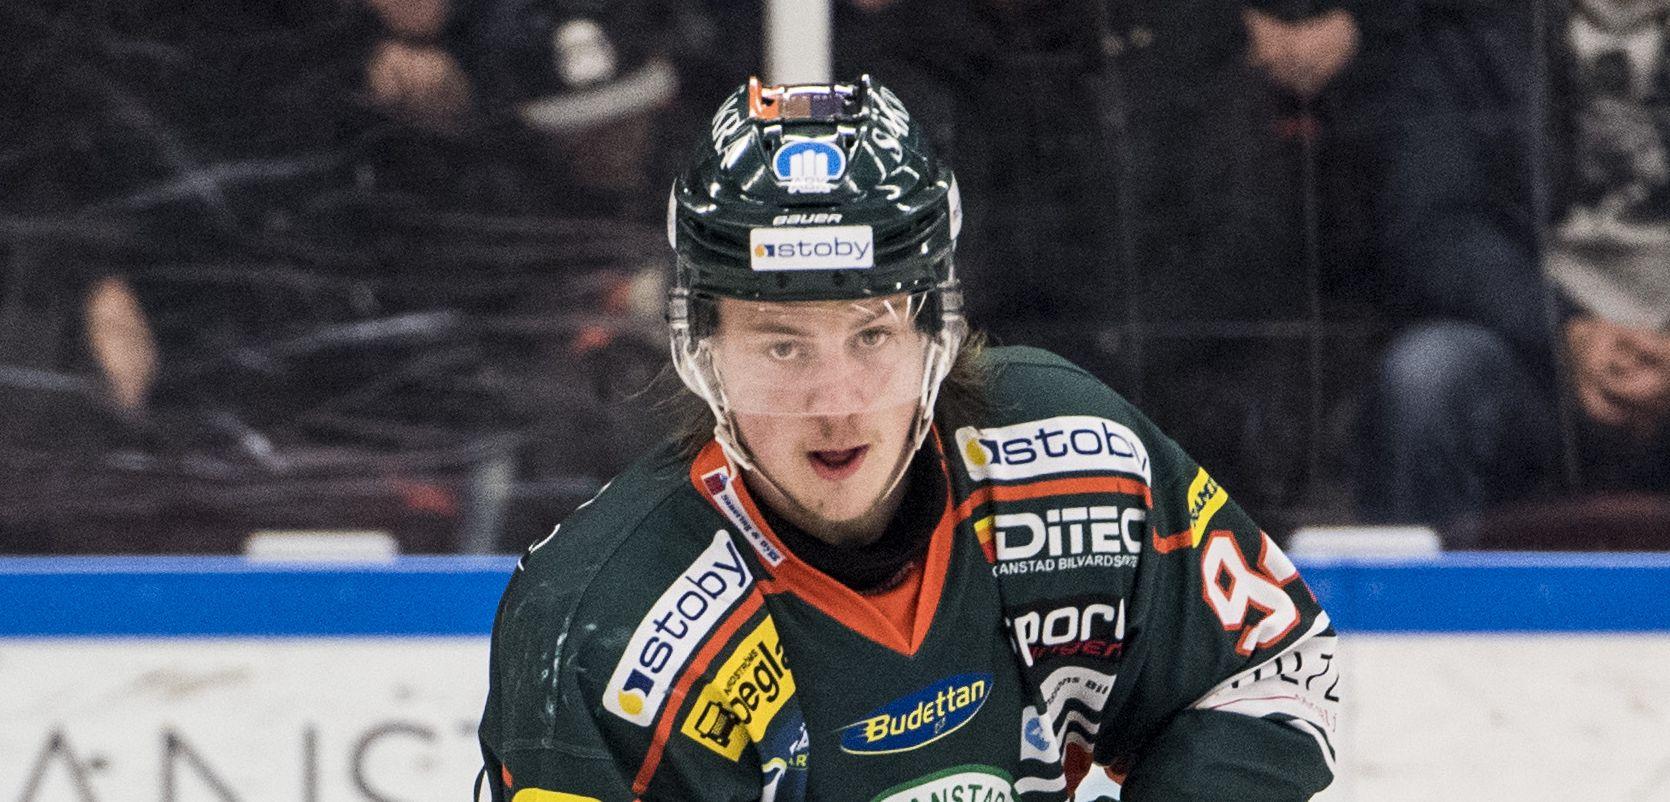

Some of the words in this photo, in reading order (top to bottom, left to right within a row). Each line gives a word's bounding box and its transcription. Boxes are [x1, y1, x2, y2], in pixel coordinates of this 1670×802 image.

[773, 213, 842, 225] BAUER
[778, 237, 869, 260] stoby
[639, 540, 747, 675] stoby
[1085, 680, 1110, 695] Bil
[865, 680, 986, 744] Budettan
